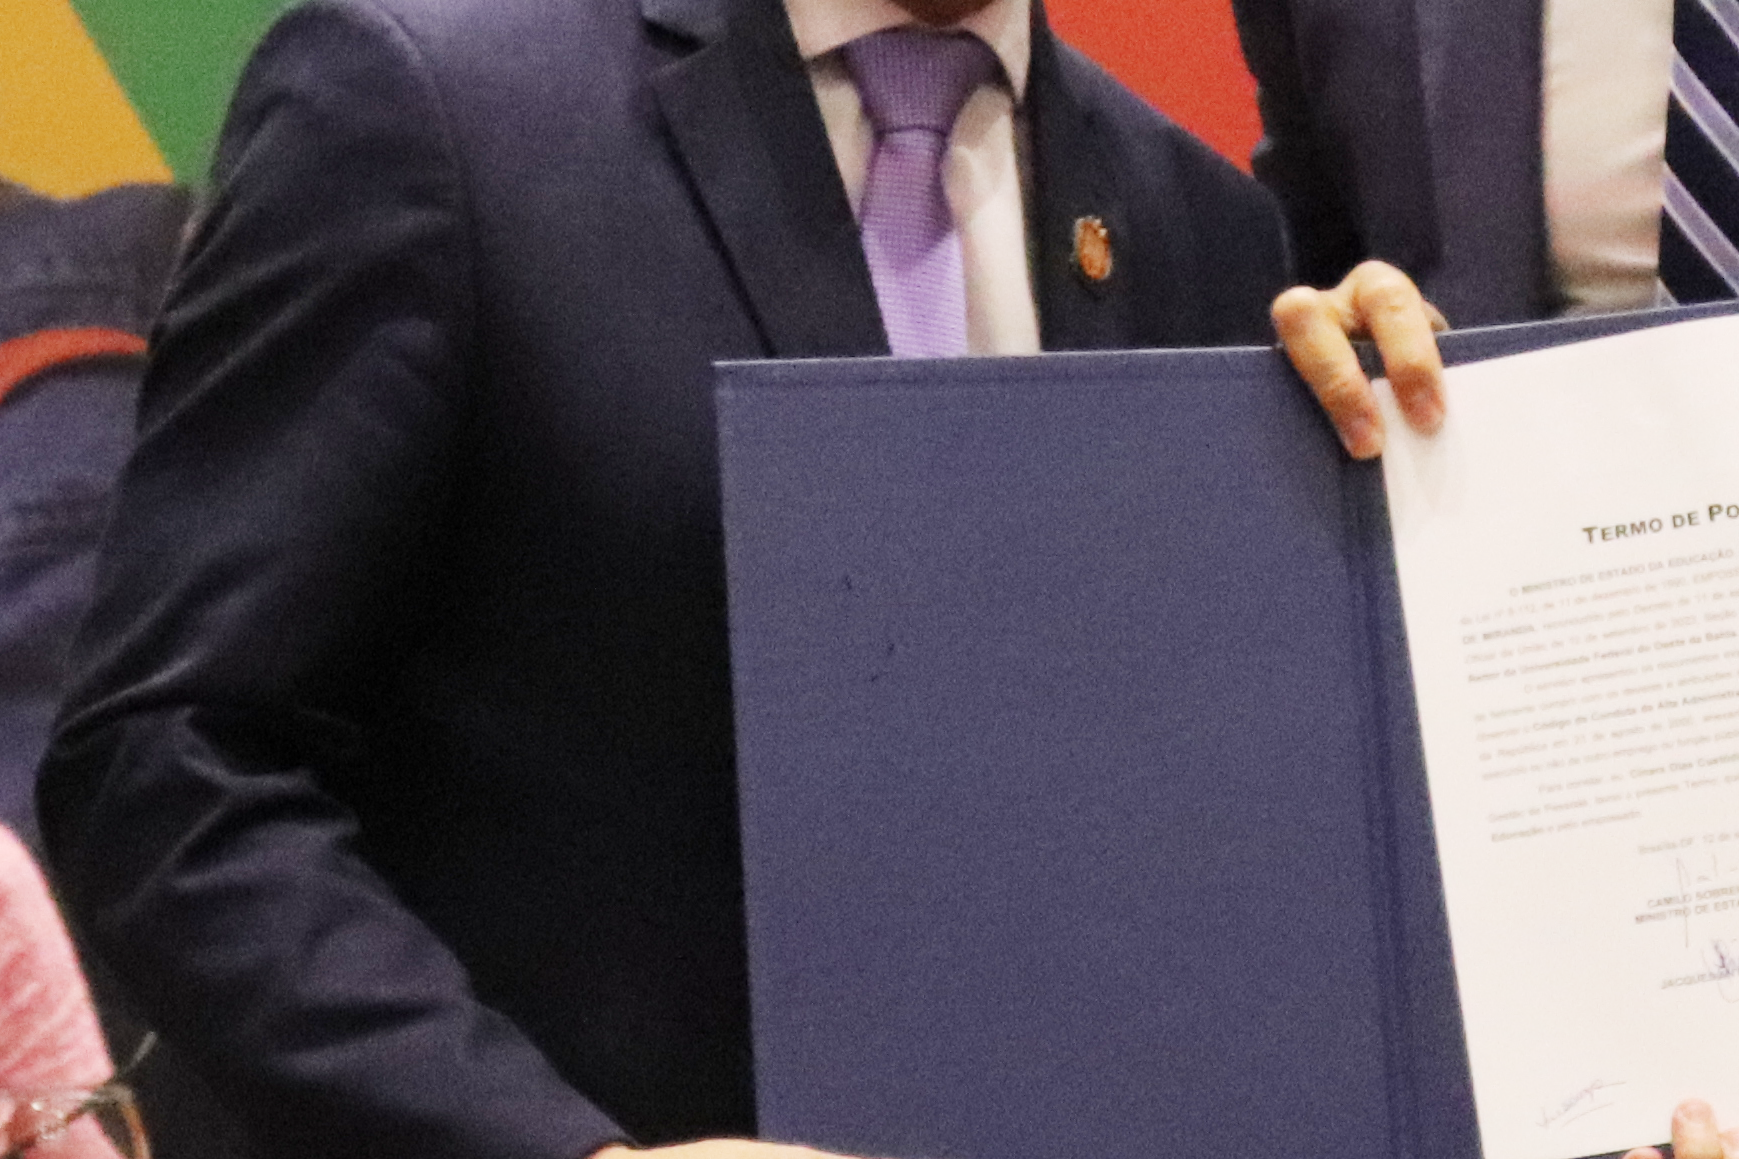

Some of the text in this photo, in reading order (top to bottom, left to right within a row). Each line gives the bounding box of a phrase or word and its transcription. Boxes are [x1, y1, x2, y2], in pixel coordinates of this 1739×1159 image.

[1581, 517, 1663, 543] TERMO
[1671, 511, 1698, 528] DE
[1646, 893, 1691, 908] CAMILO
[1633, 905, 1691, 924] MINISTRO
[1693, 903, 1709, 915] DE
